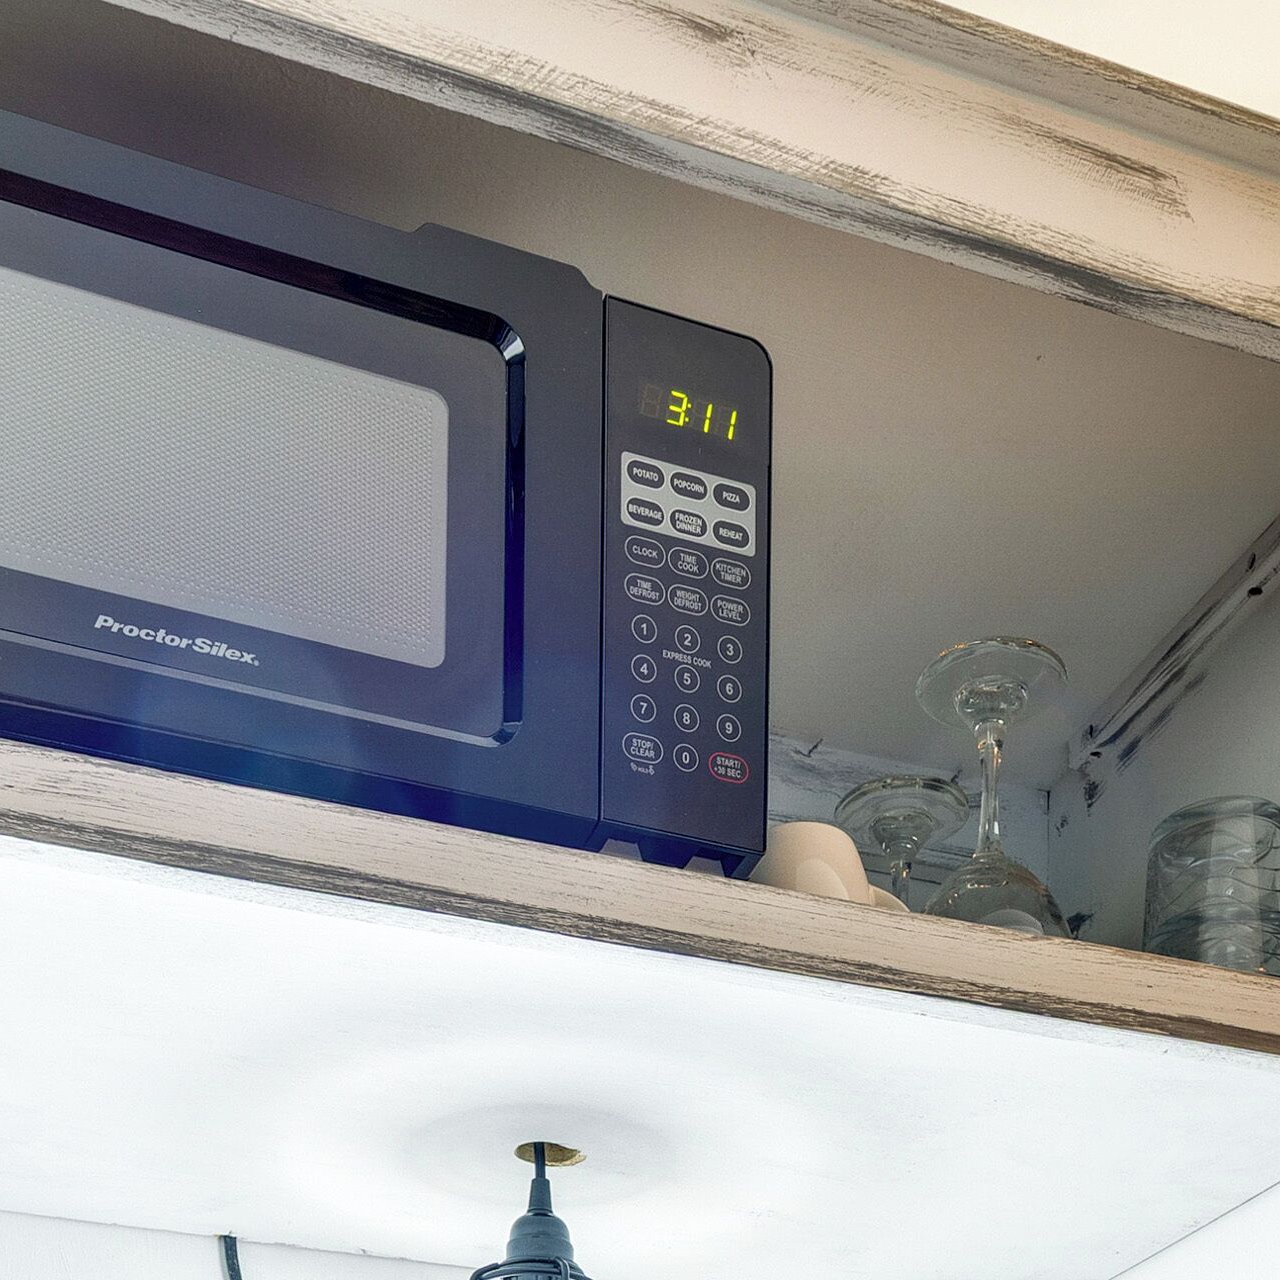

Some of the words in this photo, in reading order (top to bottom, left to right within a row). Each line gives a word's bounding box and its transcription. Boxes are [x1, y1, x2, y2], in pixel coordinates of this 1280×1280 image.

[667, 390, 737, 440] 3:11
[632, 467, 659, 482] POTATO
[673, 478, 705, 495] POPCORN
[722, 490, 741, 504] PIZZA
[628, 503, 663, 521] BEVERAGE
[675, 511, 703, 526] FROZEN
[675, 521, 702, 535] DINNER
[719, 526, 744, 541] REHEAT
[632, 544, 658, 559] CLOCK
[679, 552, 697, 565] TIME
[677, 561, 699, 574] COOK
[715, 562, 747, 578] KITCHEN
[636, 579, 652, 591] TIME
[720, 571, 742, 585] TIMER
[629, 585, 660, 600] DEFROST
[675, 589, 700, 603] WEIGHT
[673, 596, 702, 612] DEFROST
[717, 599, 744, 613] POWER
[719, 608, 742, 621] LEVEL
[640, 622, 648, 636] 1
[683, 633, 692, 647] 2
[726, 643, 735, 656] 3
[662, 649, 692, 664] EXPRESS
[692, 657, 712, 669] COOK
[640, 662, 649, 676] 4
[683, 672, 692, 685] 5
[725, 682, 734, 696] 6
[639, 701, 648, 715] 7
[682, 711, 691, 725] 8
[725, 721, 734, 735] 9
[632, 738, 654, 749] STOP/
[630, 746, 655, 759] CLEAR
[682, 751, 690, 764] 0
[716, 755, 741, 769] START/
